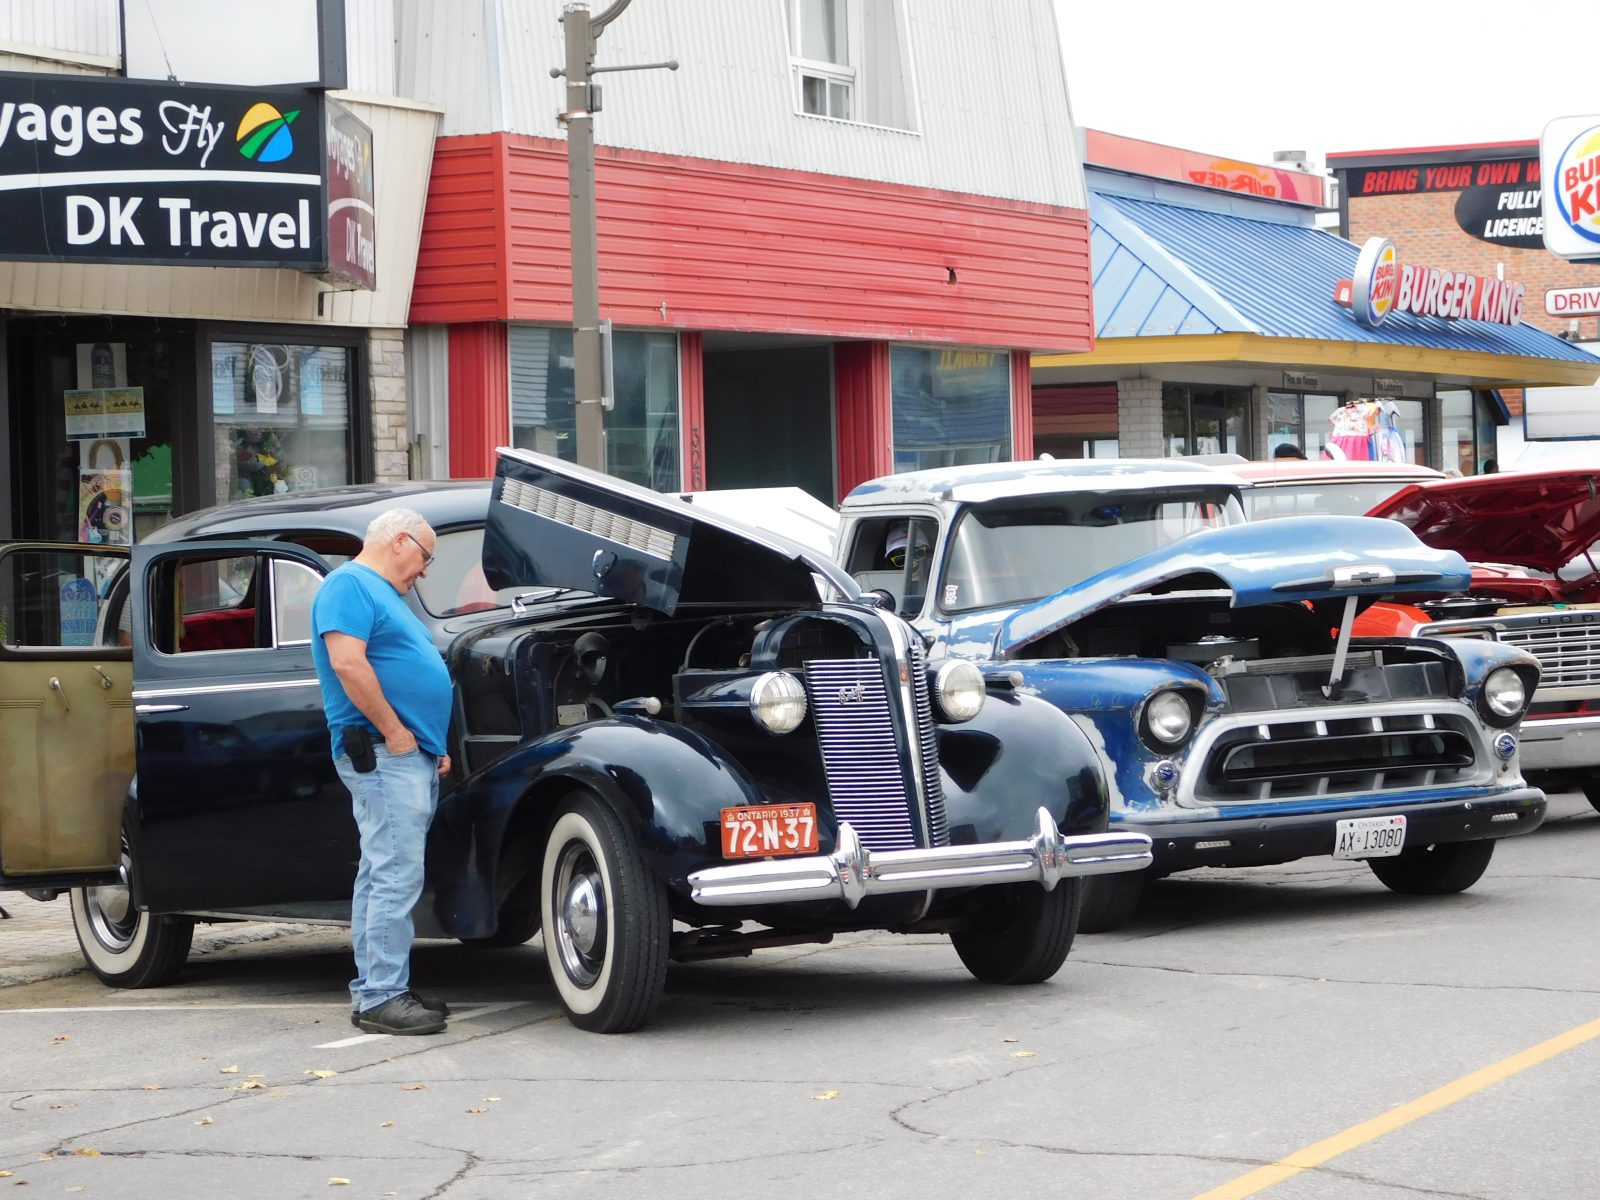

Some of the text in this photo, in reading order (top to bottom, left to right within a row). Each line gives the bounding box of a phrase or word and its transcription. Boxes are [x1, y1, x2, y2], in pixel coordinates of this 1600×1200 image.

[158, 100, 225, 168] Fly
[1363, 168, 1418, 193] BRING
[1425, 164, 1472, 189] YOUR
[1476, 161, 1521, 186] OWN
[1497, 190, 1542, 211] FULLY
[66, 195, 311, 250] DK Travel
[345, 216, 357, 266] DK
[1398, 264, 1526, 326] BURGER KING
[737, 808, 800, 821] ONTARIO 1937
